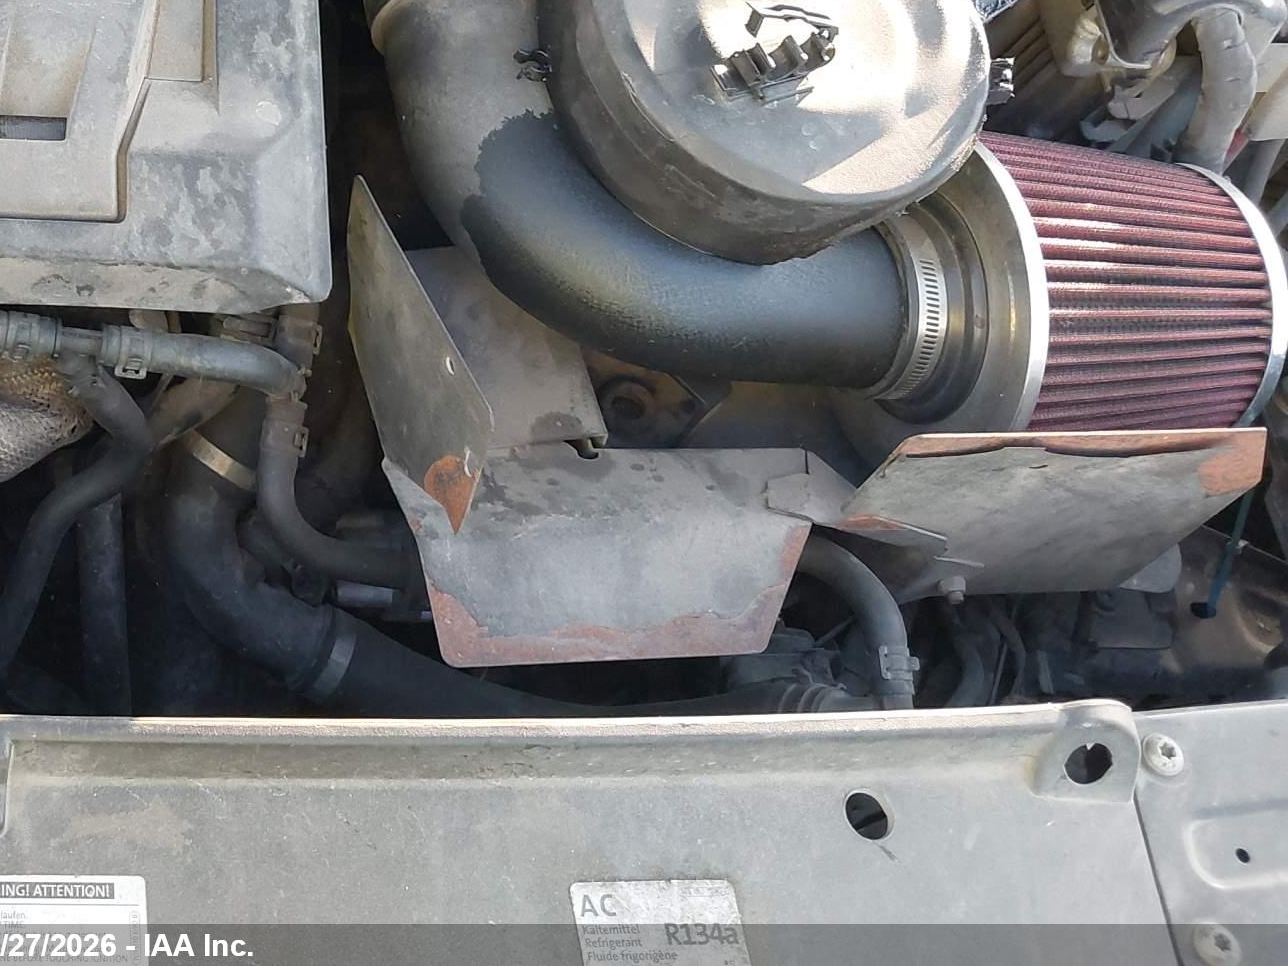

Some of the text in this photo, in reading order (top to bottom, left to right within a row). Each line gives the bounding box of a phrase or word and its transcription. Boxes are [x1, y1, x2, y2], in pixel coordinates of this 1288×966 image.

[33, 884, 111, 898] ATTENTION!
[579, 893, 617, 918] AC
[665, 922, 740, 946] R134a
[585, 936, 643, 950] Refrigerant
[587, 950, 620, 963] Fluide
